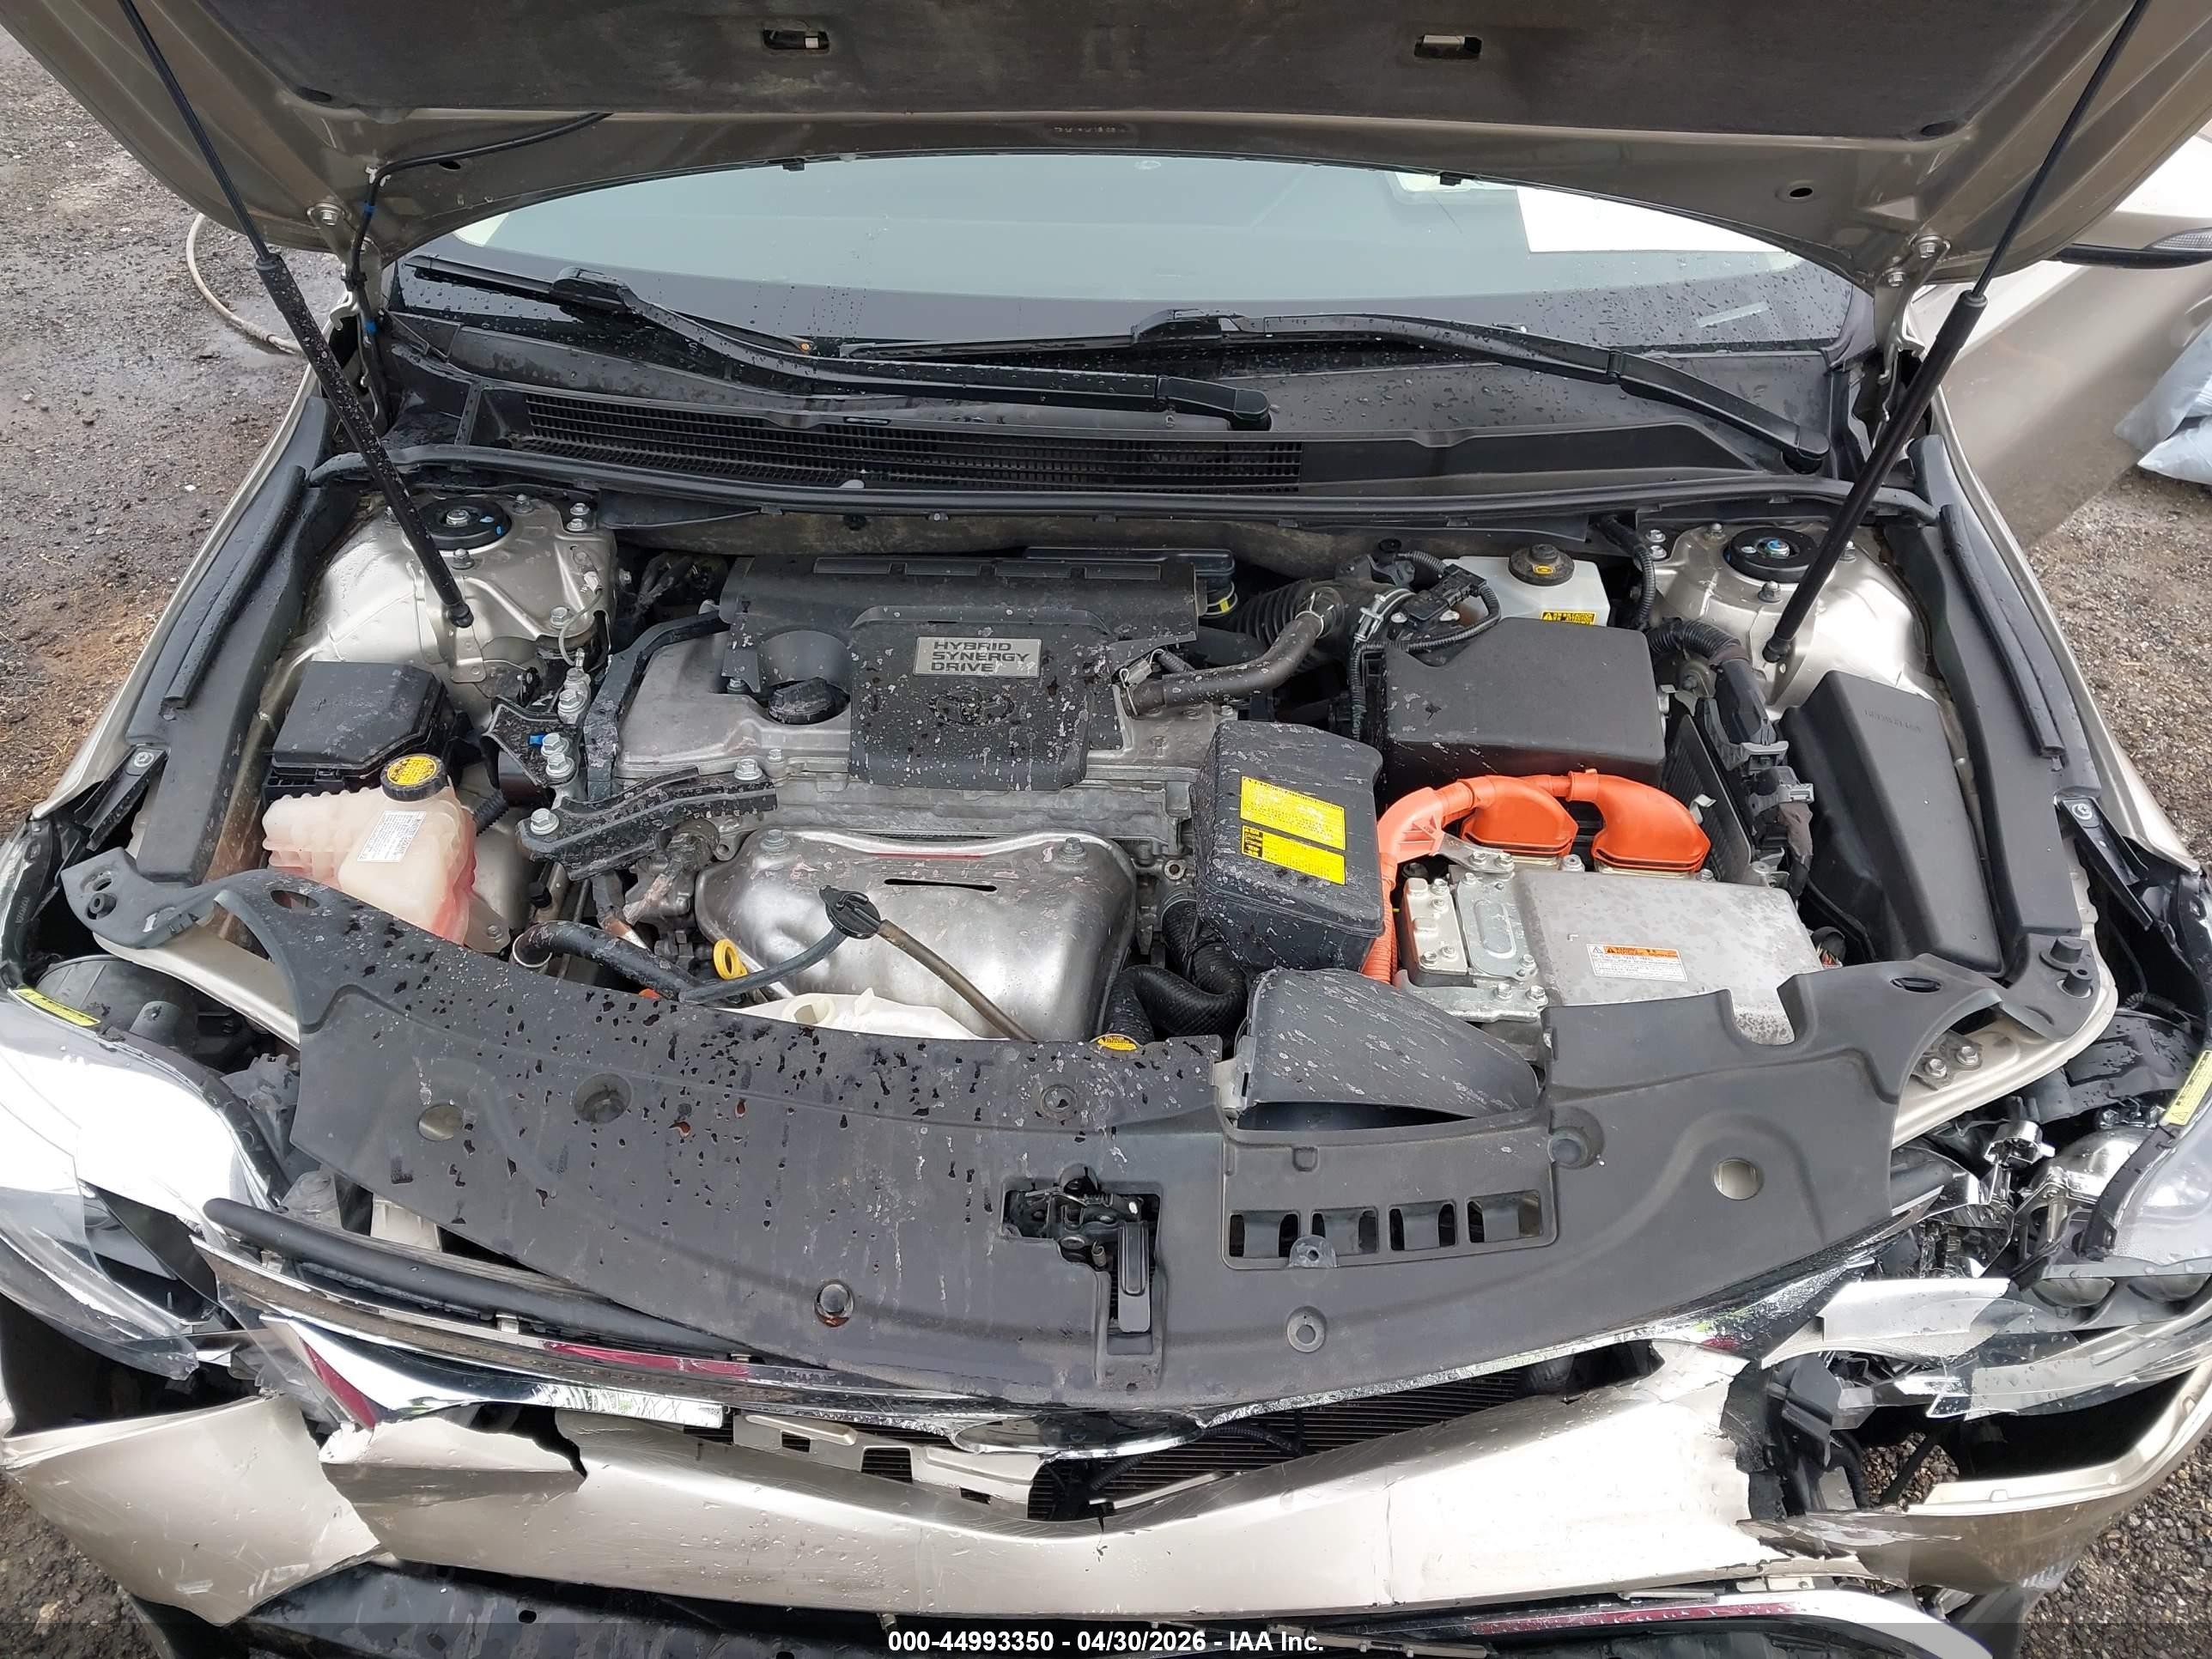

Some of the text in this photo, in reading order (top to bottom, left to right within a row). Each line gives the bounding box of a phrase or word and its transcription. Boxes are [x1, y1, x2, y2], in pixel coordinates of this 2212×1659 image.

[933, 641, 1012, 651] HYBRID
[932, 652, 1030, 662] SYNERGY
[931, 662, 994, 672] DRIVE
